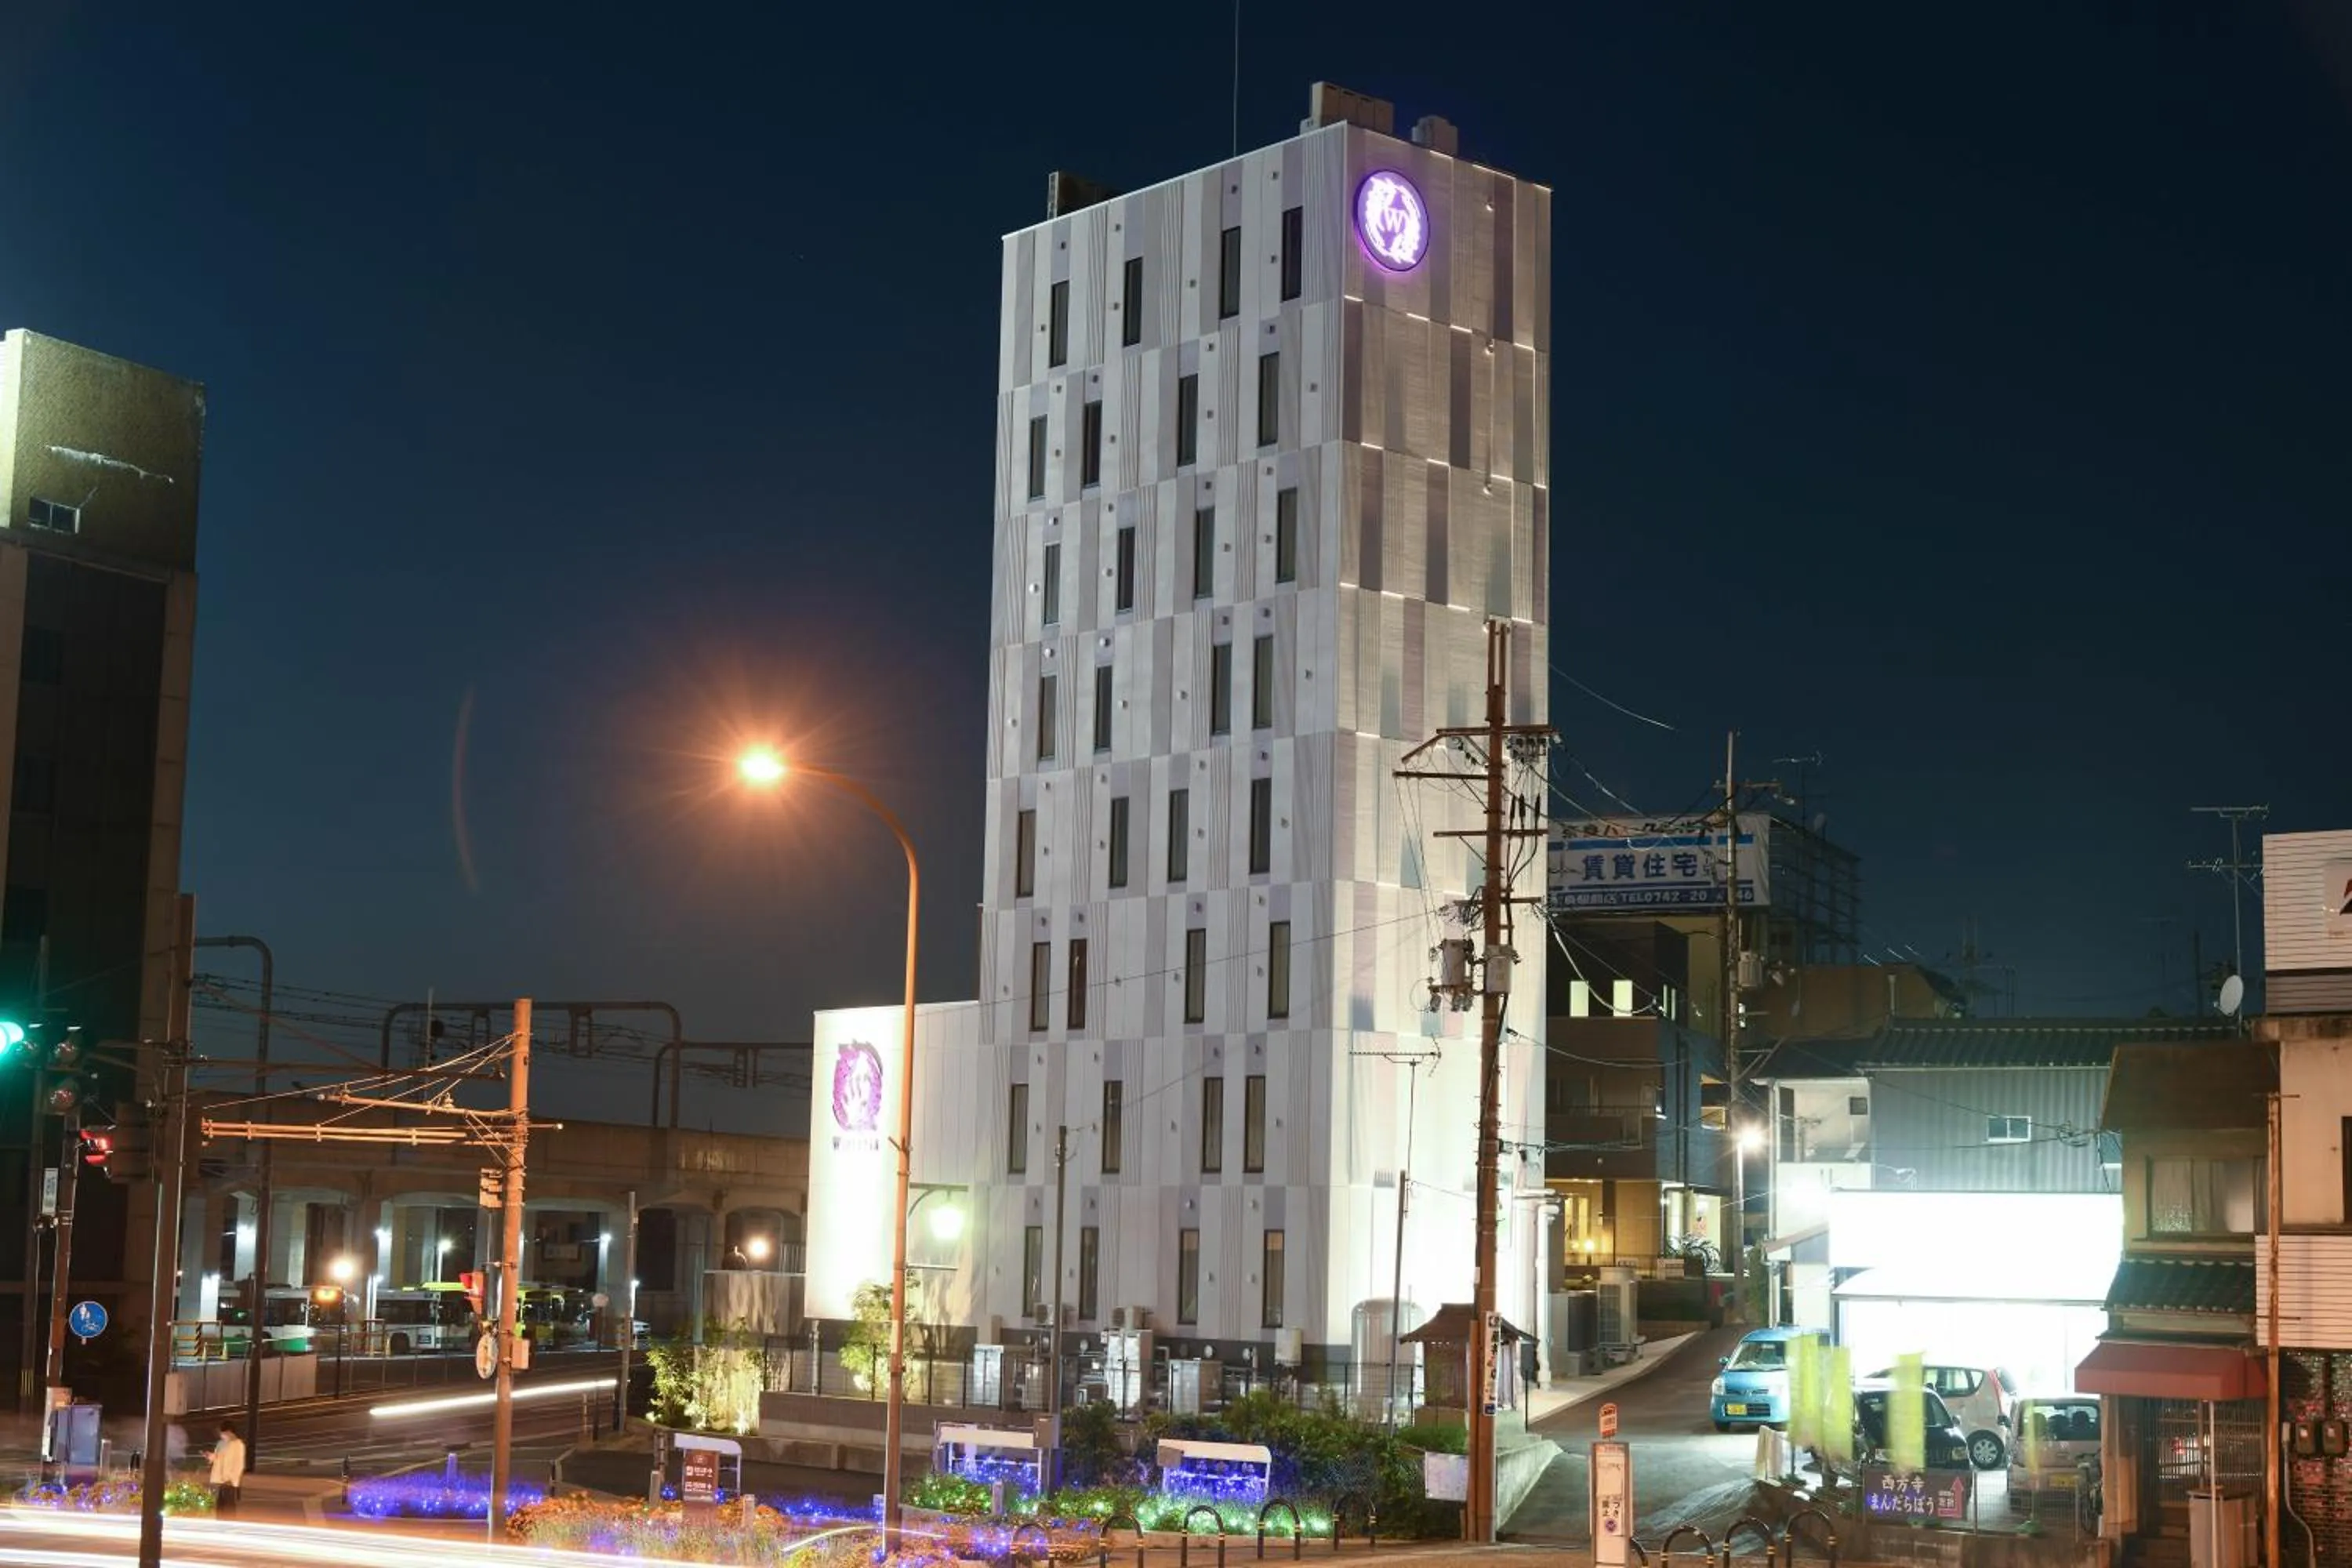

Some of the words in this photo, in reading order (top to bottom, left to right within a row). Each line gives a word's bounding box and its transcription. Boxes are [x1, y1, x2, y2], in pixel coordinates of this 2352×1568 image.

[1582, 852, 1698, 881] 賃貸住宅
[1882, 1475, 1925, 1494] 西方寺
[1871, 1493, 1934, 1515] まんだらぼう
